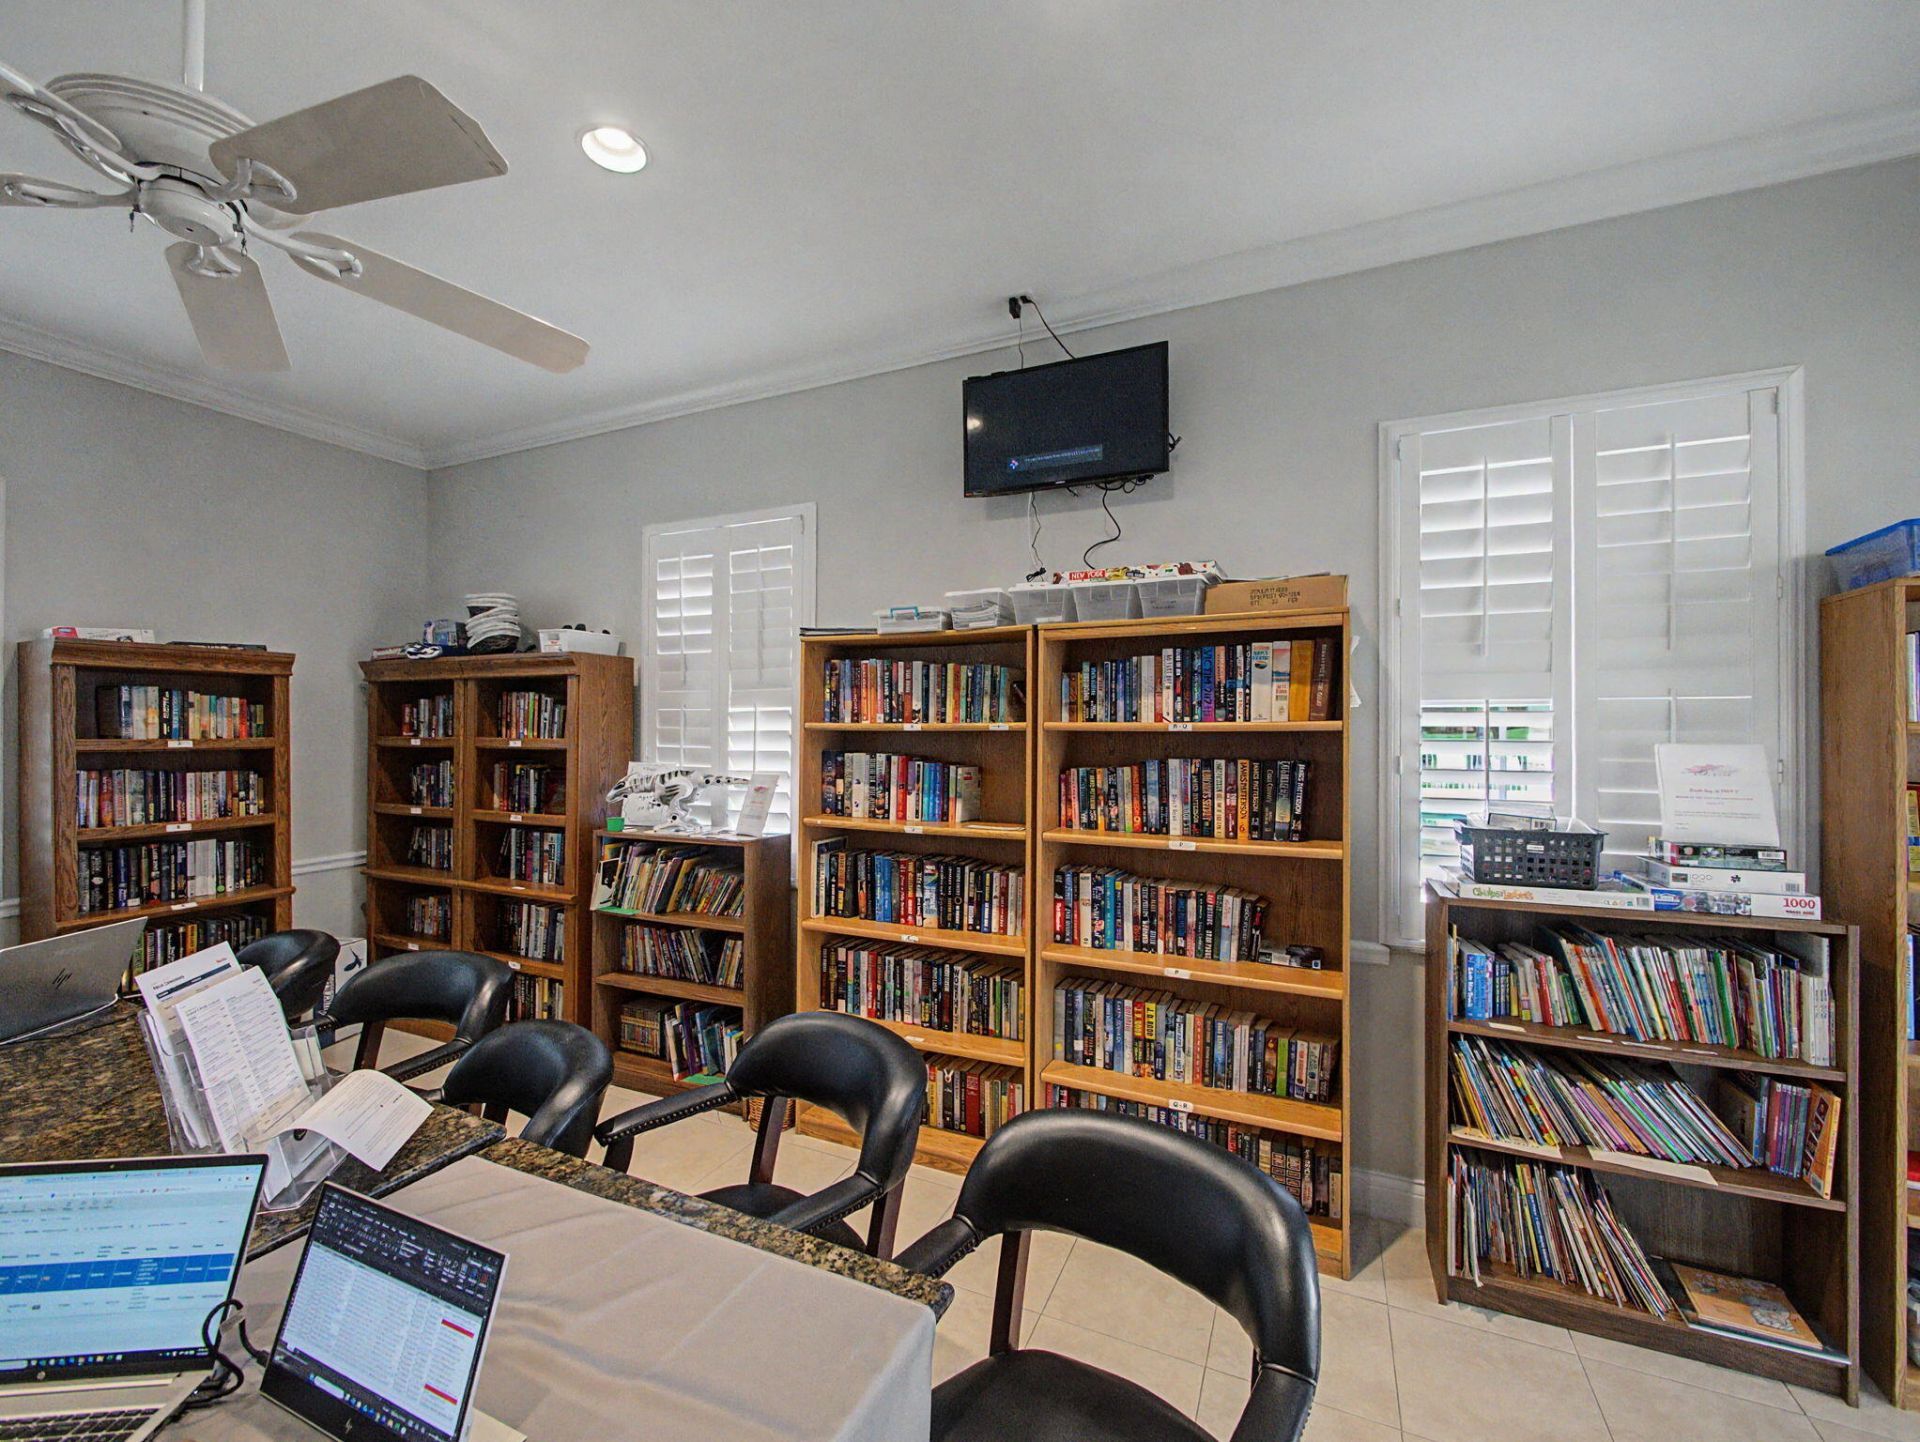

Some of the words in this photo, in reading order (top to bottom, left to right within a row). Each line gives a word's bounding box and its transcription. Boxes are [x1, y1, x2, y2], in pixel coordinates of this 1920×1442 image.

[1071, 572, 1085, 580] NEW
[1295, 783, 1304, 814] PATTERSON
[1783, 898, 1816, 909] 1000
